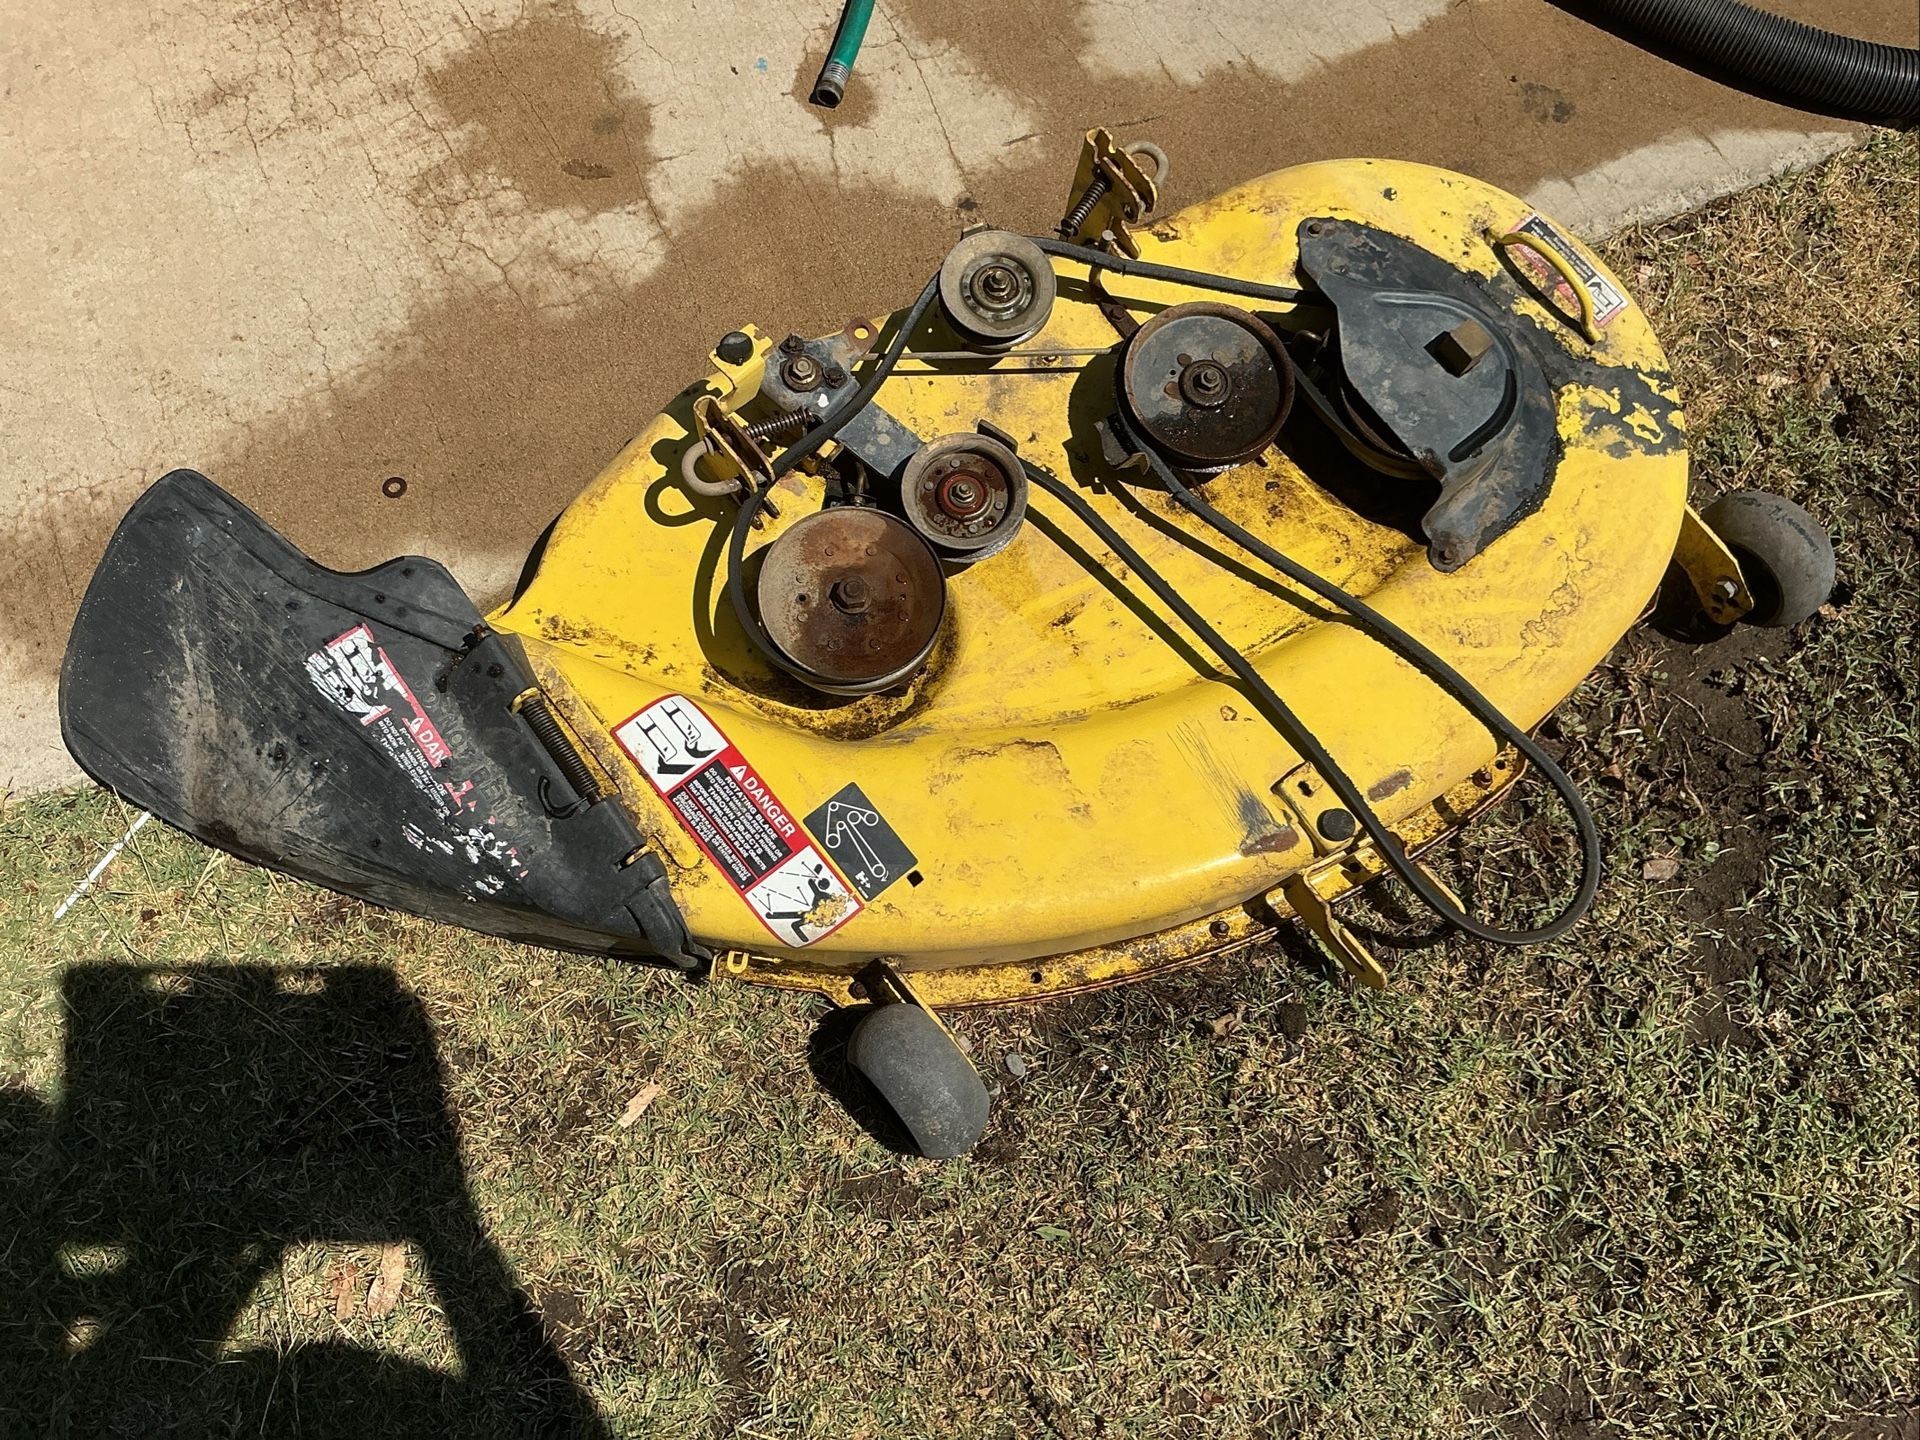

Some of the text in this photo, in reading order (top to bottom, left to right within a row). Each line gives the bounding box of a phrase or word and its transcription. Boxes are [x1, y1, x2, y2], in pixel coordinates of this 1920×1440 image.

[383, 716, 393, 726] DO
[389, 725, 399, 737] NOT
[671, 797, 710, 842] CATCHER IN PLACE
[675, 794, 747, 881] DISCHARGE CHUTE OR ENTIRE GRASS
[680, 791, 751, 877] DO NOT OPERATE MOWER WITHOUT
[686, 782, 749, 858] THAT MAY BE THROWN BY BLADE
[692, 779, 709, 798] BEFORE
[721, 815, 736, 832] CLEAR
[732, 830, 745, 843] AREA
[742, 841, 751, 850] OF
[747, 848, 767, 870] OBJECTS
[703, 770, 715, 783] INTO
[712, 782, 730, 802] MOWER
[739, 815, 756, 834] ENGINE
[753, 832, 760, 840] IS
[757, 838, 778, 862] RUNNING
[706, 786, 763, 854] THROWN OBJECTS
[708, 767, 717, 776] DO
[714, 775, 725, 786] NOT
[722, 784, 733, 796] PUT
[744, 811, 753, 820] OR
[750, 819, 762, 832] FEET
[760, 830, 776, 849] UNDER
[773, 848, 783, 857] OR
[724, 775, 778, 840] ROTATING BLADE
[742, 775, 796, 838] DANGER
